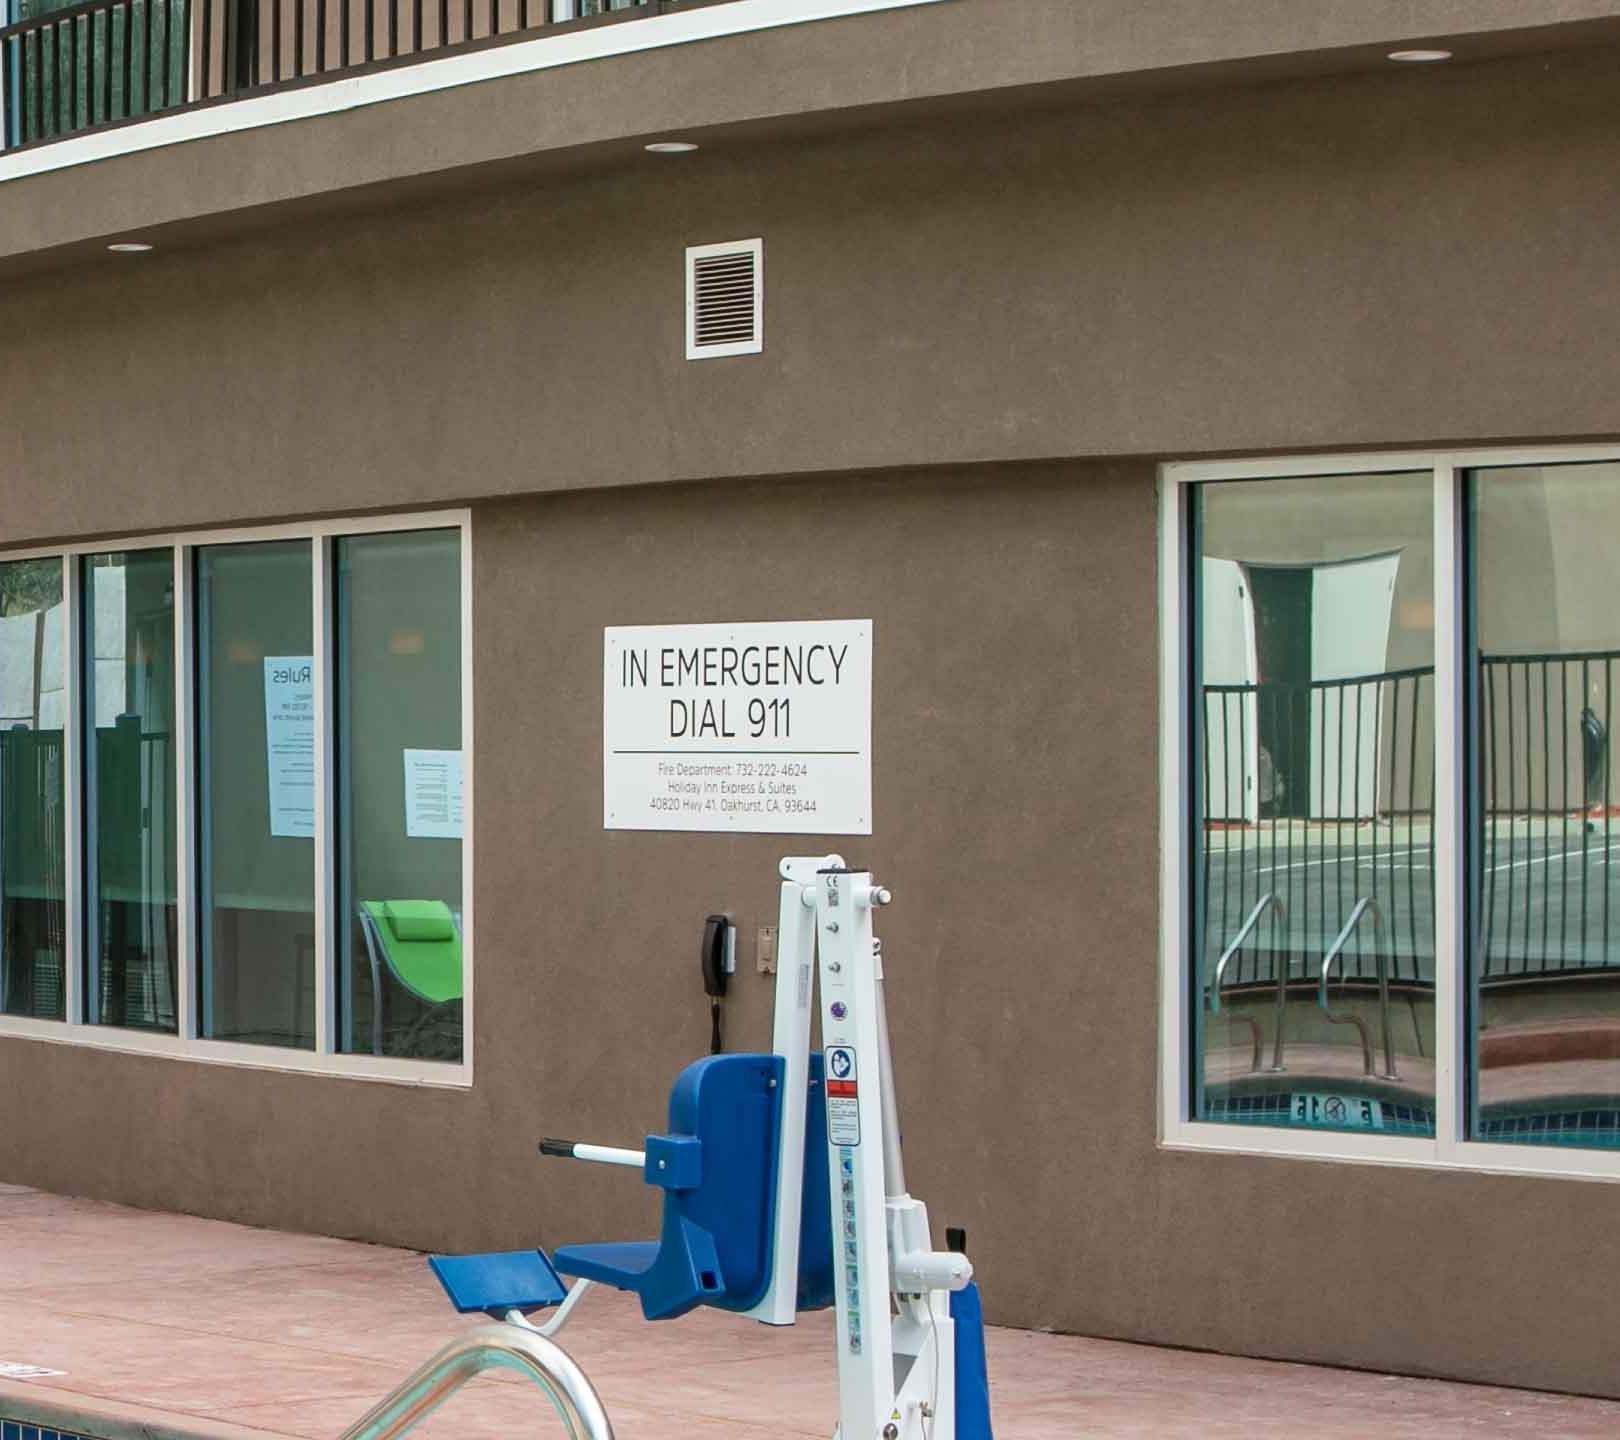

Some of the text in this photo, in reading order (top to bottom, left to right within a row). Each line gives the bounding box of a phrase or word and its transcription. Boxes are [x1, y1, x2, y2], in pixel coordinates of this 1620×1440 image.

[622, 644, 848, 687] IN EMERGENCY
[669, 697, 791, 738] DIAL 911
[658, 762, 674, 776] Fire
[736, 763, 808, 777] 732-222-4624
[668, 779, 798, 796] Holiday Inn Express & Suites
[784, 799, 817, 813] 93644
